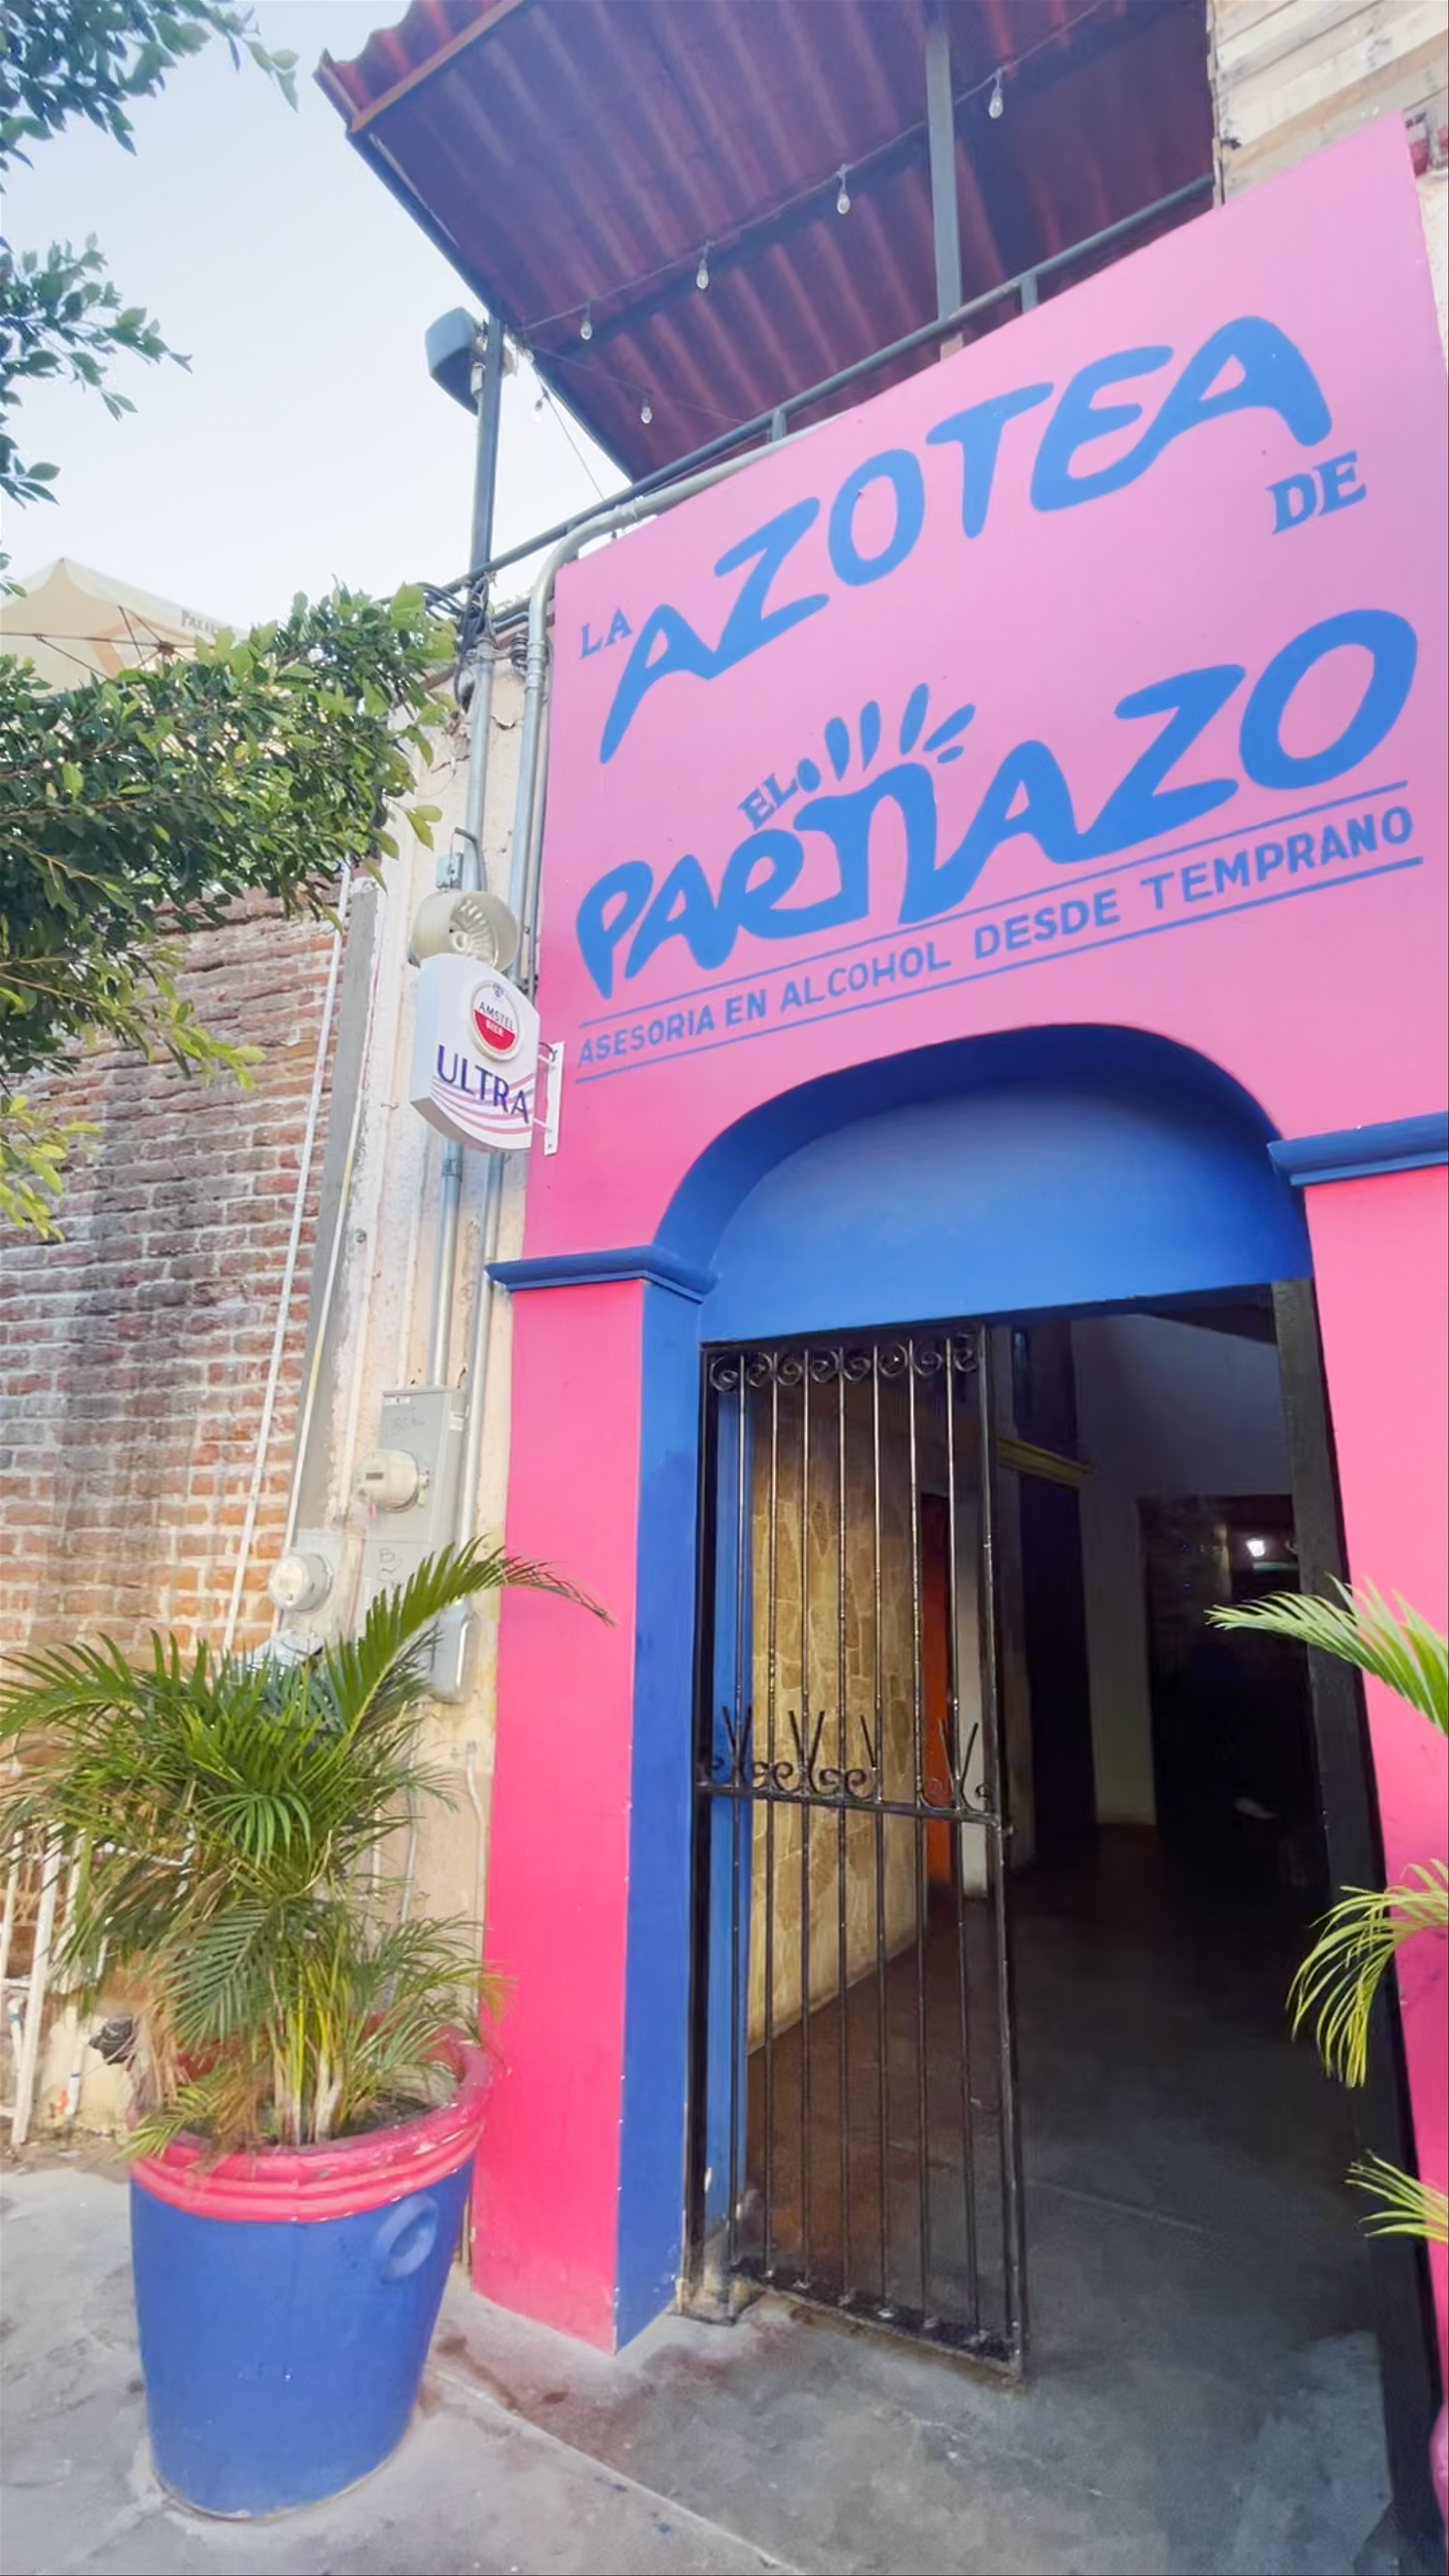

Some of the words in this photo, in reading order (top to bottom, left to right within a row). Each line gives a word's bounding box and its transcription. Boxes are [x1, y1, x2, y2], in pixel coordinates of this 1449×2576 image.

[1266, 450, 1368, 535] DE
[598, 316, 1331, 765] AZOTEA
[580, 608, 632, 659] LA
[738, 772, 799, 831] EL
[577, 1005, 715, 1068] ASESORIA
[724, 990, 768, 1027] EN
[779, 944, 951, 1012] ALCOHOL
[974, 889, 1120, 961] DESDE
[1138, 806, 1414, 912] TEMPRANO
[478, 1002, 514, 1032] AMSTEL
[437, 1044, 529, 1124] ULTRA
